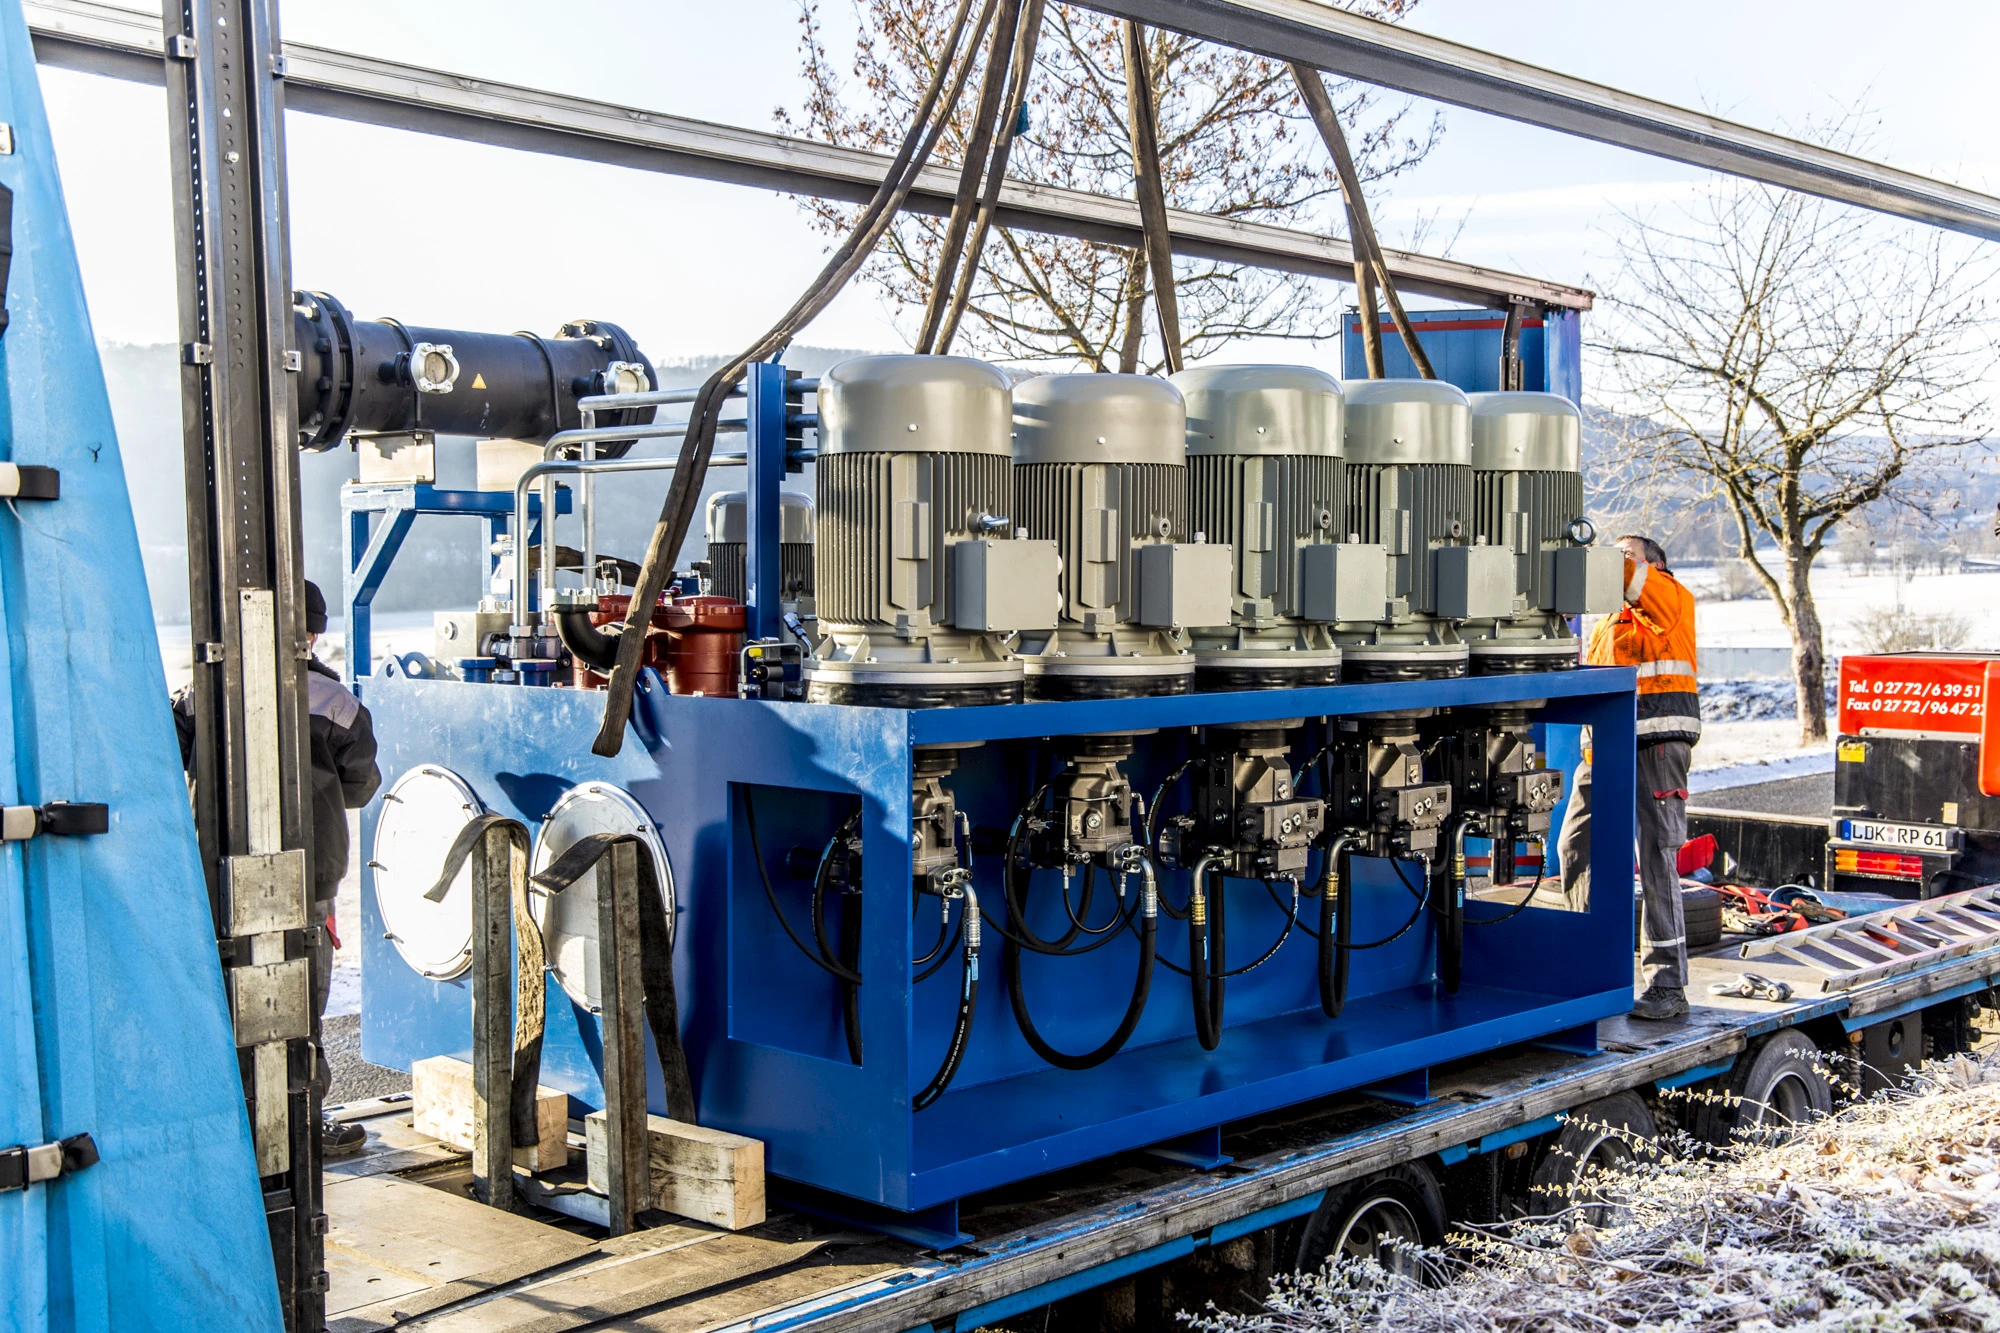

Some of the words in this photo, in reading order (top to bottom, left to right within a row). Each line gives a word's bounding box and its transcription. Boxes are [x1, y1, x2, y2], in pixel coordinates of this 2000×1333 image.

[1848, 680, 1869, 693] Tel.
[1846, 698, 1870, 711] Fax
[1853, 824, 1885, 842] LDK
[1898, 828, 1919, 844] RP
[1923, 831, 1945, 847] 61
